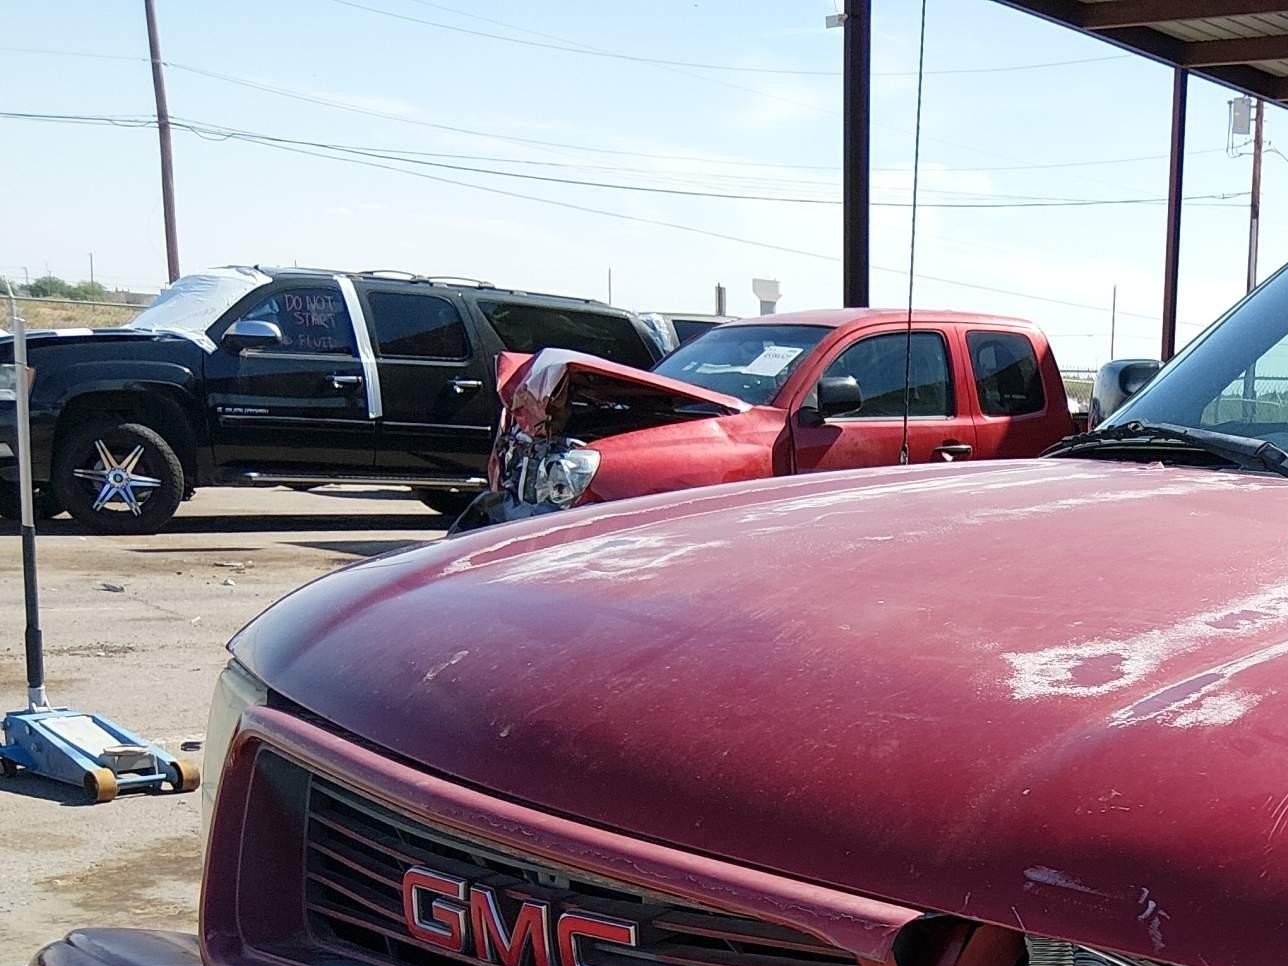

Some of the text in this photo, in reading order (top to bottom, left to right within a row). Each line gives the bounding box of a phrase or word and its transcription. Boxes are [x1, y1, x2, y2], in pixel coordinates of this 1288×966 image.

[284, 294, 334, 312] DO NOT
[294, 311, 336, 329] START
